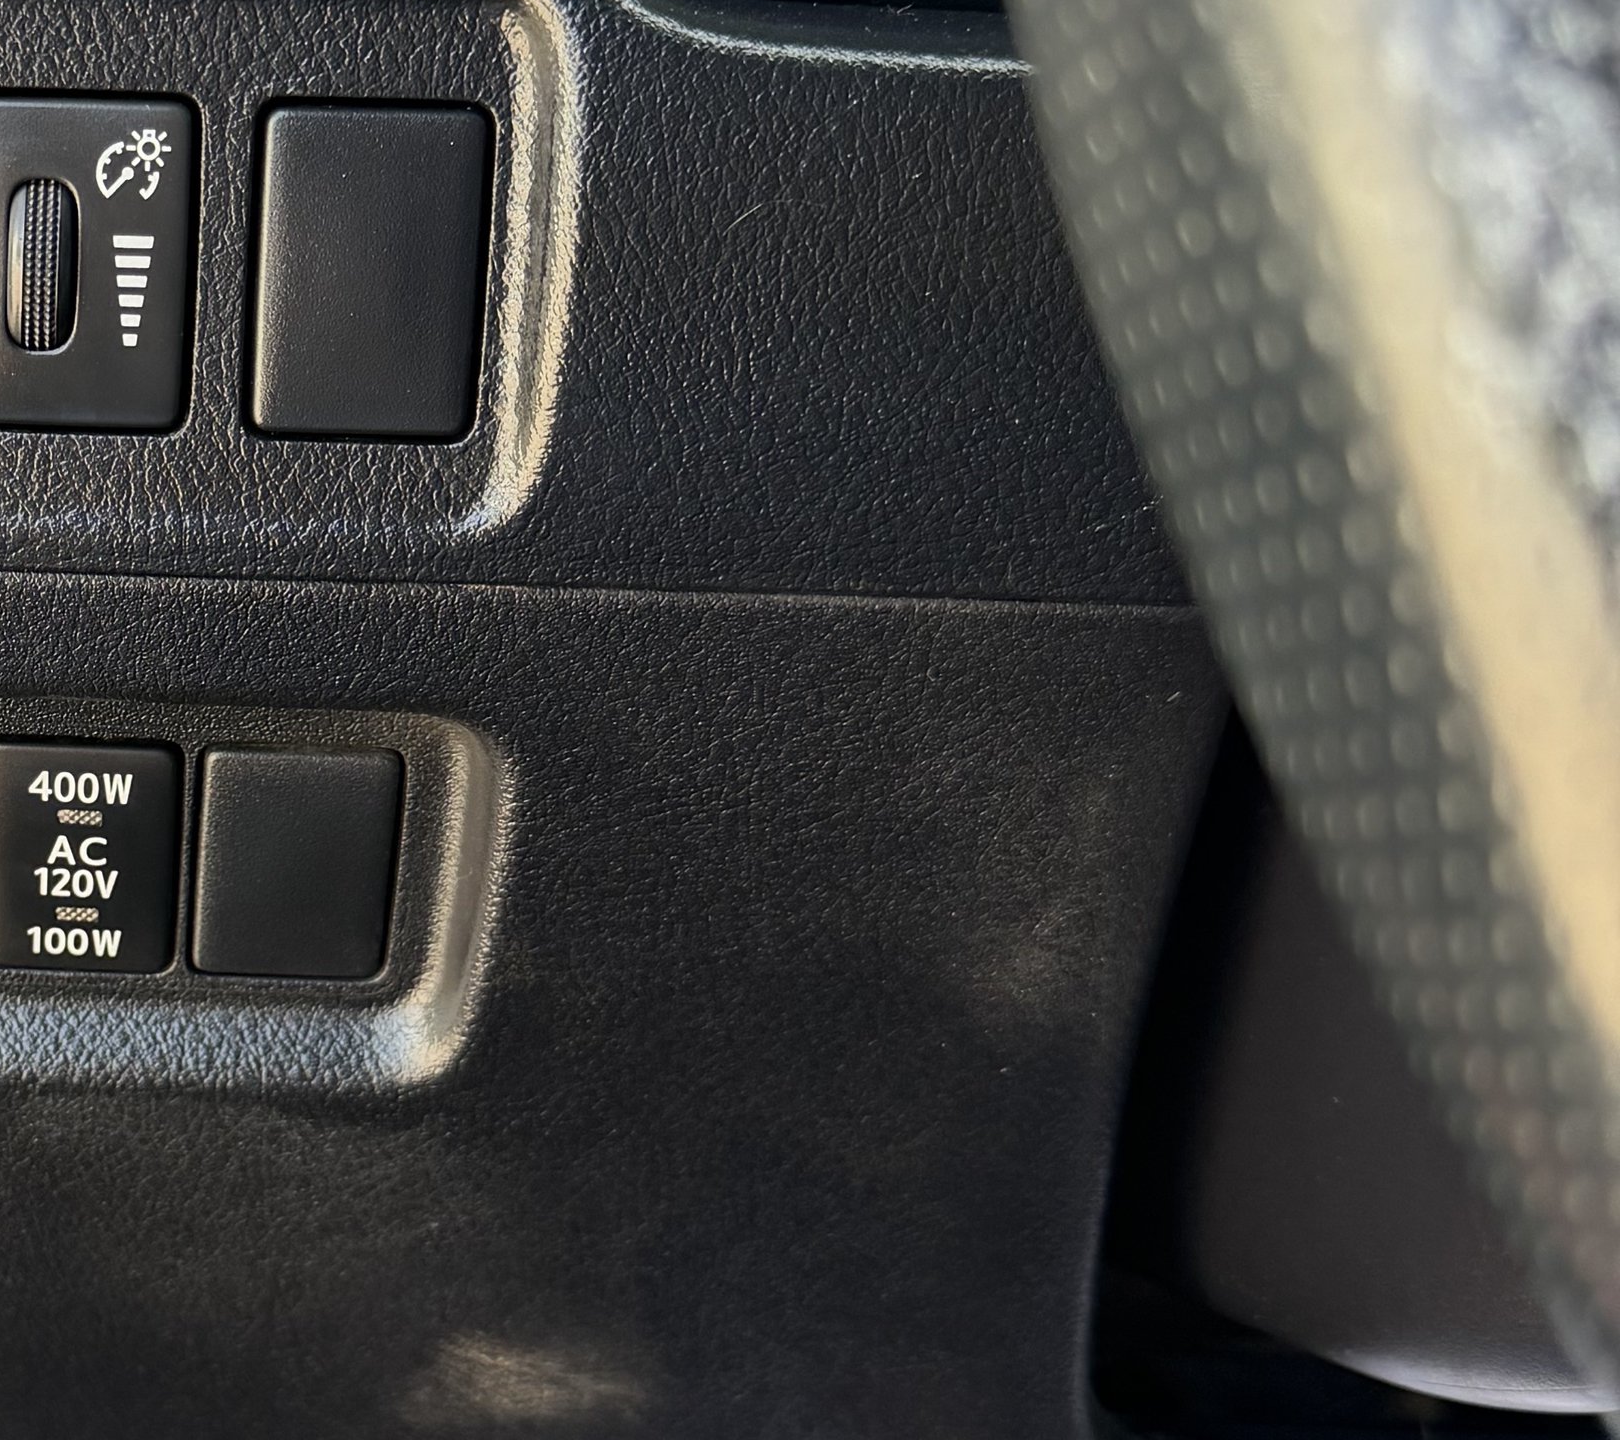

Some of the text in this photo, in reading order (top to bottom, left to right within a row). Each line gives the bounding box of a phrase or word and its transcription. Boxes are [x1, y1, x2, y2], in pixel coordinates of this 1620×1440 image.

[27, 769, 134, 806] 400W
[47, 834, 108, 867] AC
[33, 866, 119, 900] 120V
[25, 926, 123, 959] 100W
